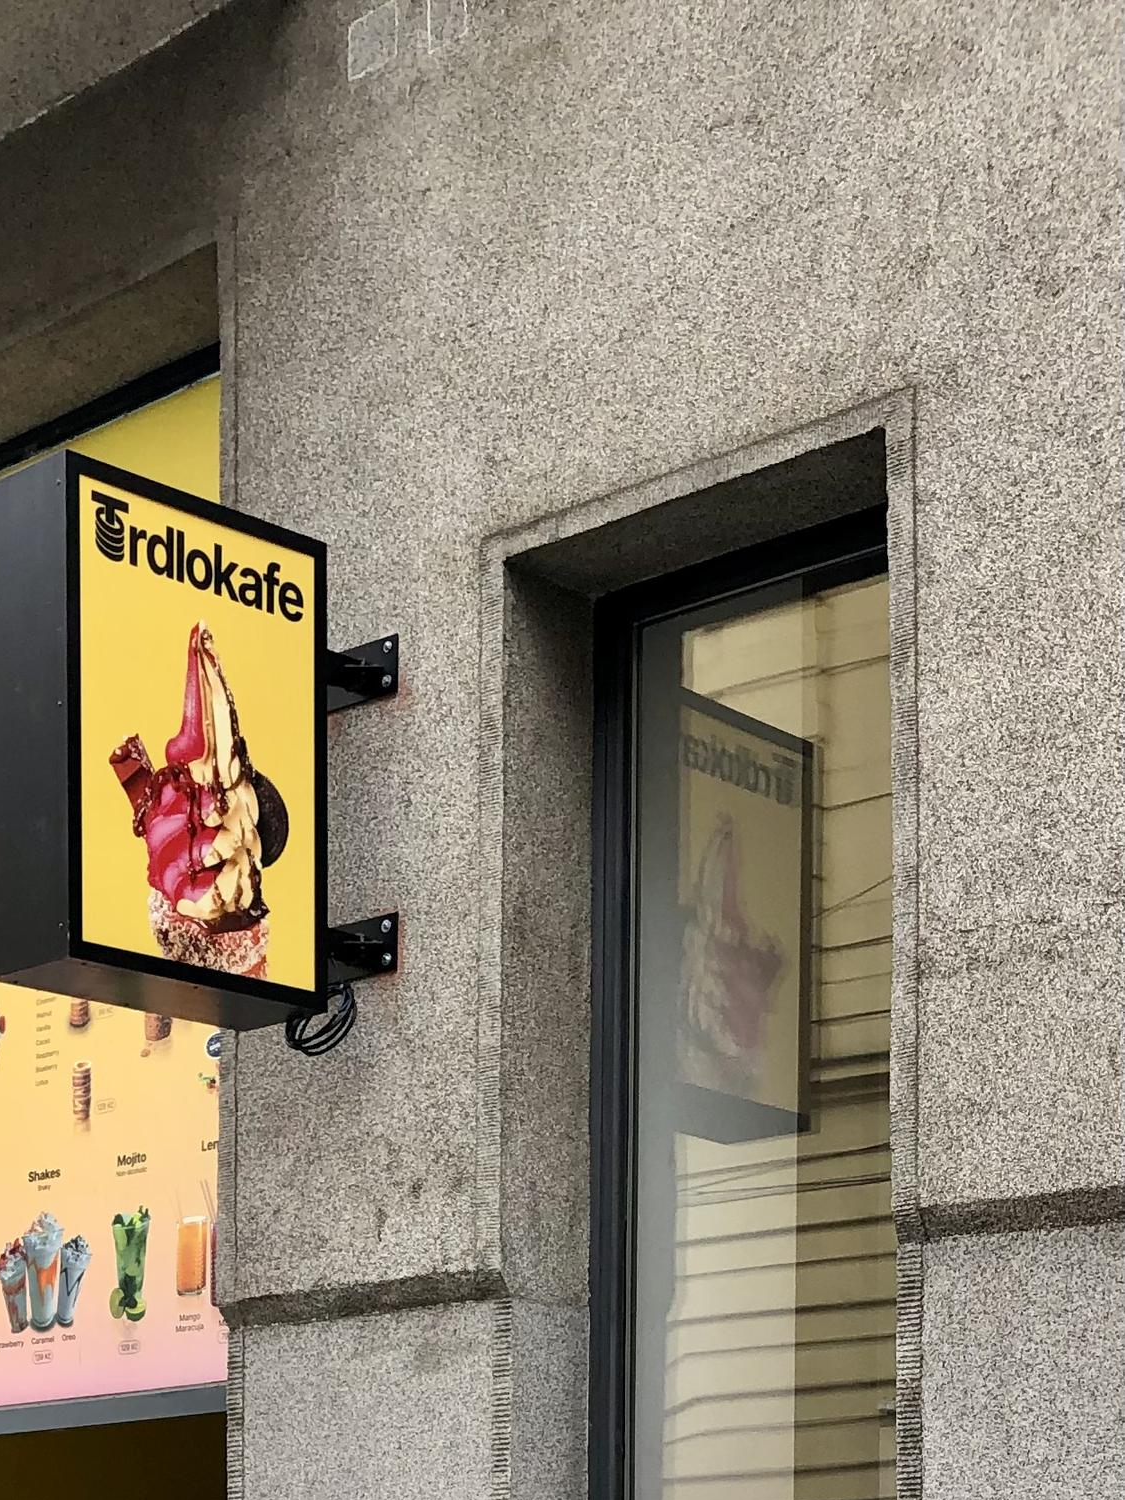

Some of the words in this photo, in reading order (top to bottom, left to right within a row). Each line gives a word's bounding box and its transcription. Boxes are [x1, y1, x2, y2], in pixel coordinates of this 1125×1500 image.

[91, 489, 304, 623] Trdlokafe
[117, 1152, 147, 1167] Mojito
[28, 1168, 61, 1183] Shakes
[179, 1313, 201, 1323] Mango
[31, 1336, 55, 1345] Caramel
